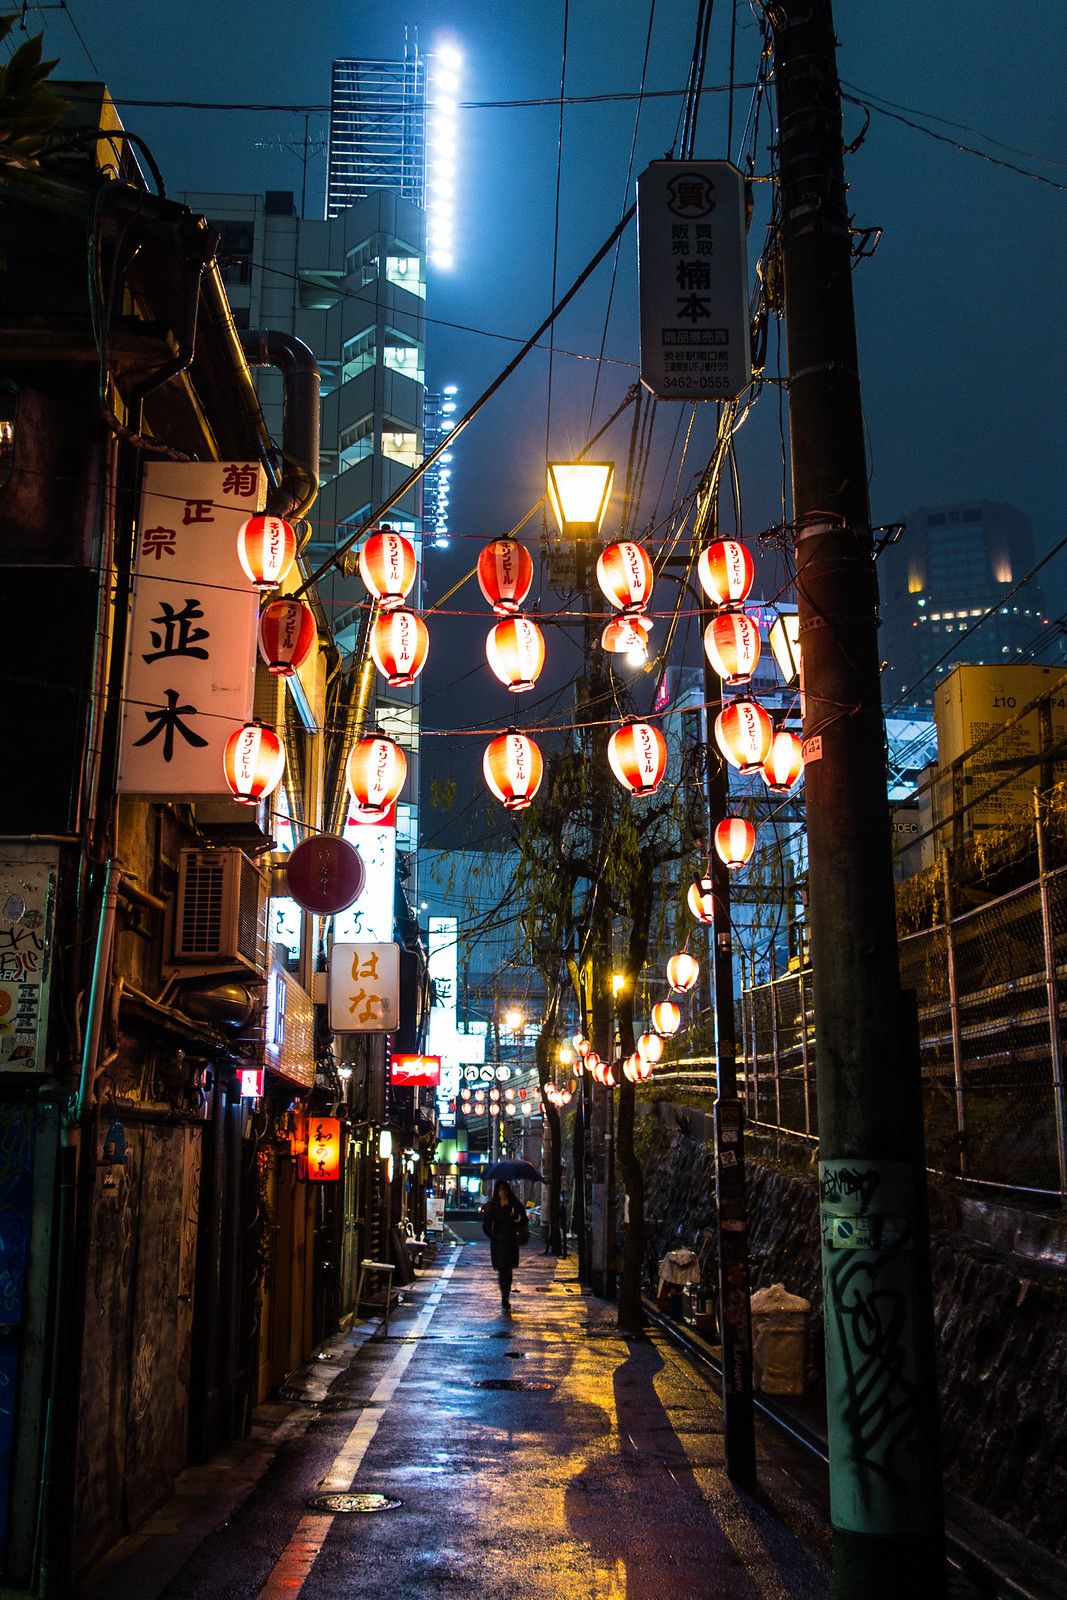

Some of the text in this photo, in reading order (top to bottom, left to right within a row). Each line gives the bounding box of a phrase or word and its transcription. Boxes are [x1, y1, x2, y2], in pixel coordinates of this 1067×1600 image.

[676, 261, 711, 324] 楠本
[664, 377, 729, 388] 3462-0555
[141, 463, 257, 560] 菊正宗
[133, 599, 209, 763] 並木
[347, 951, 380, 1024] はな
